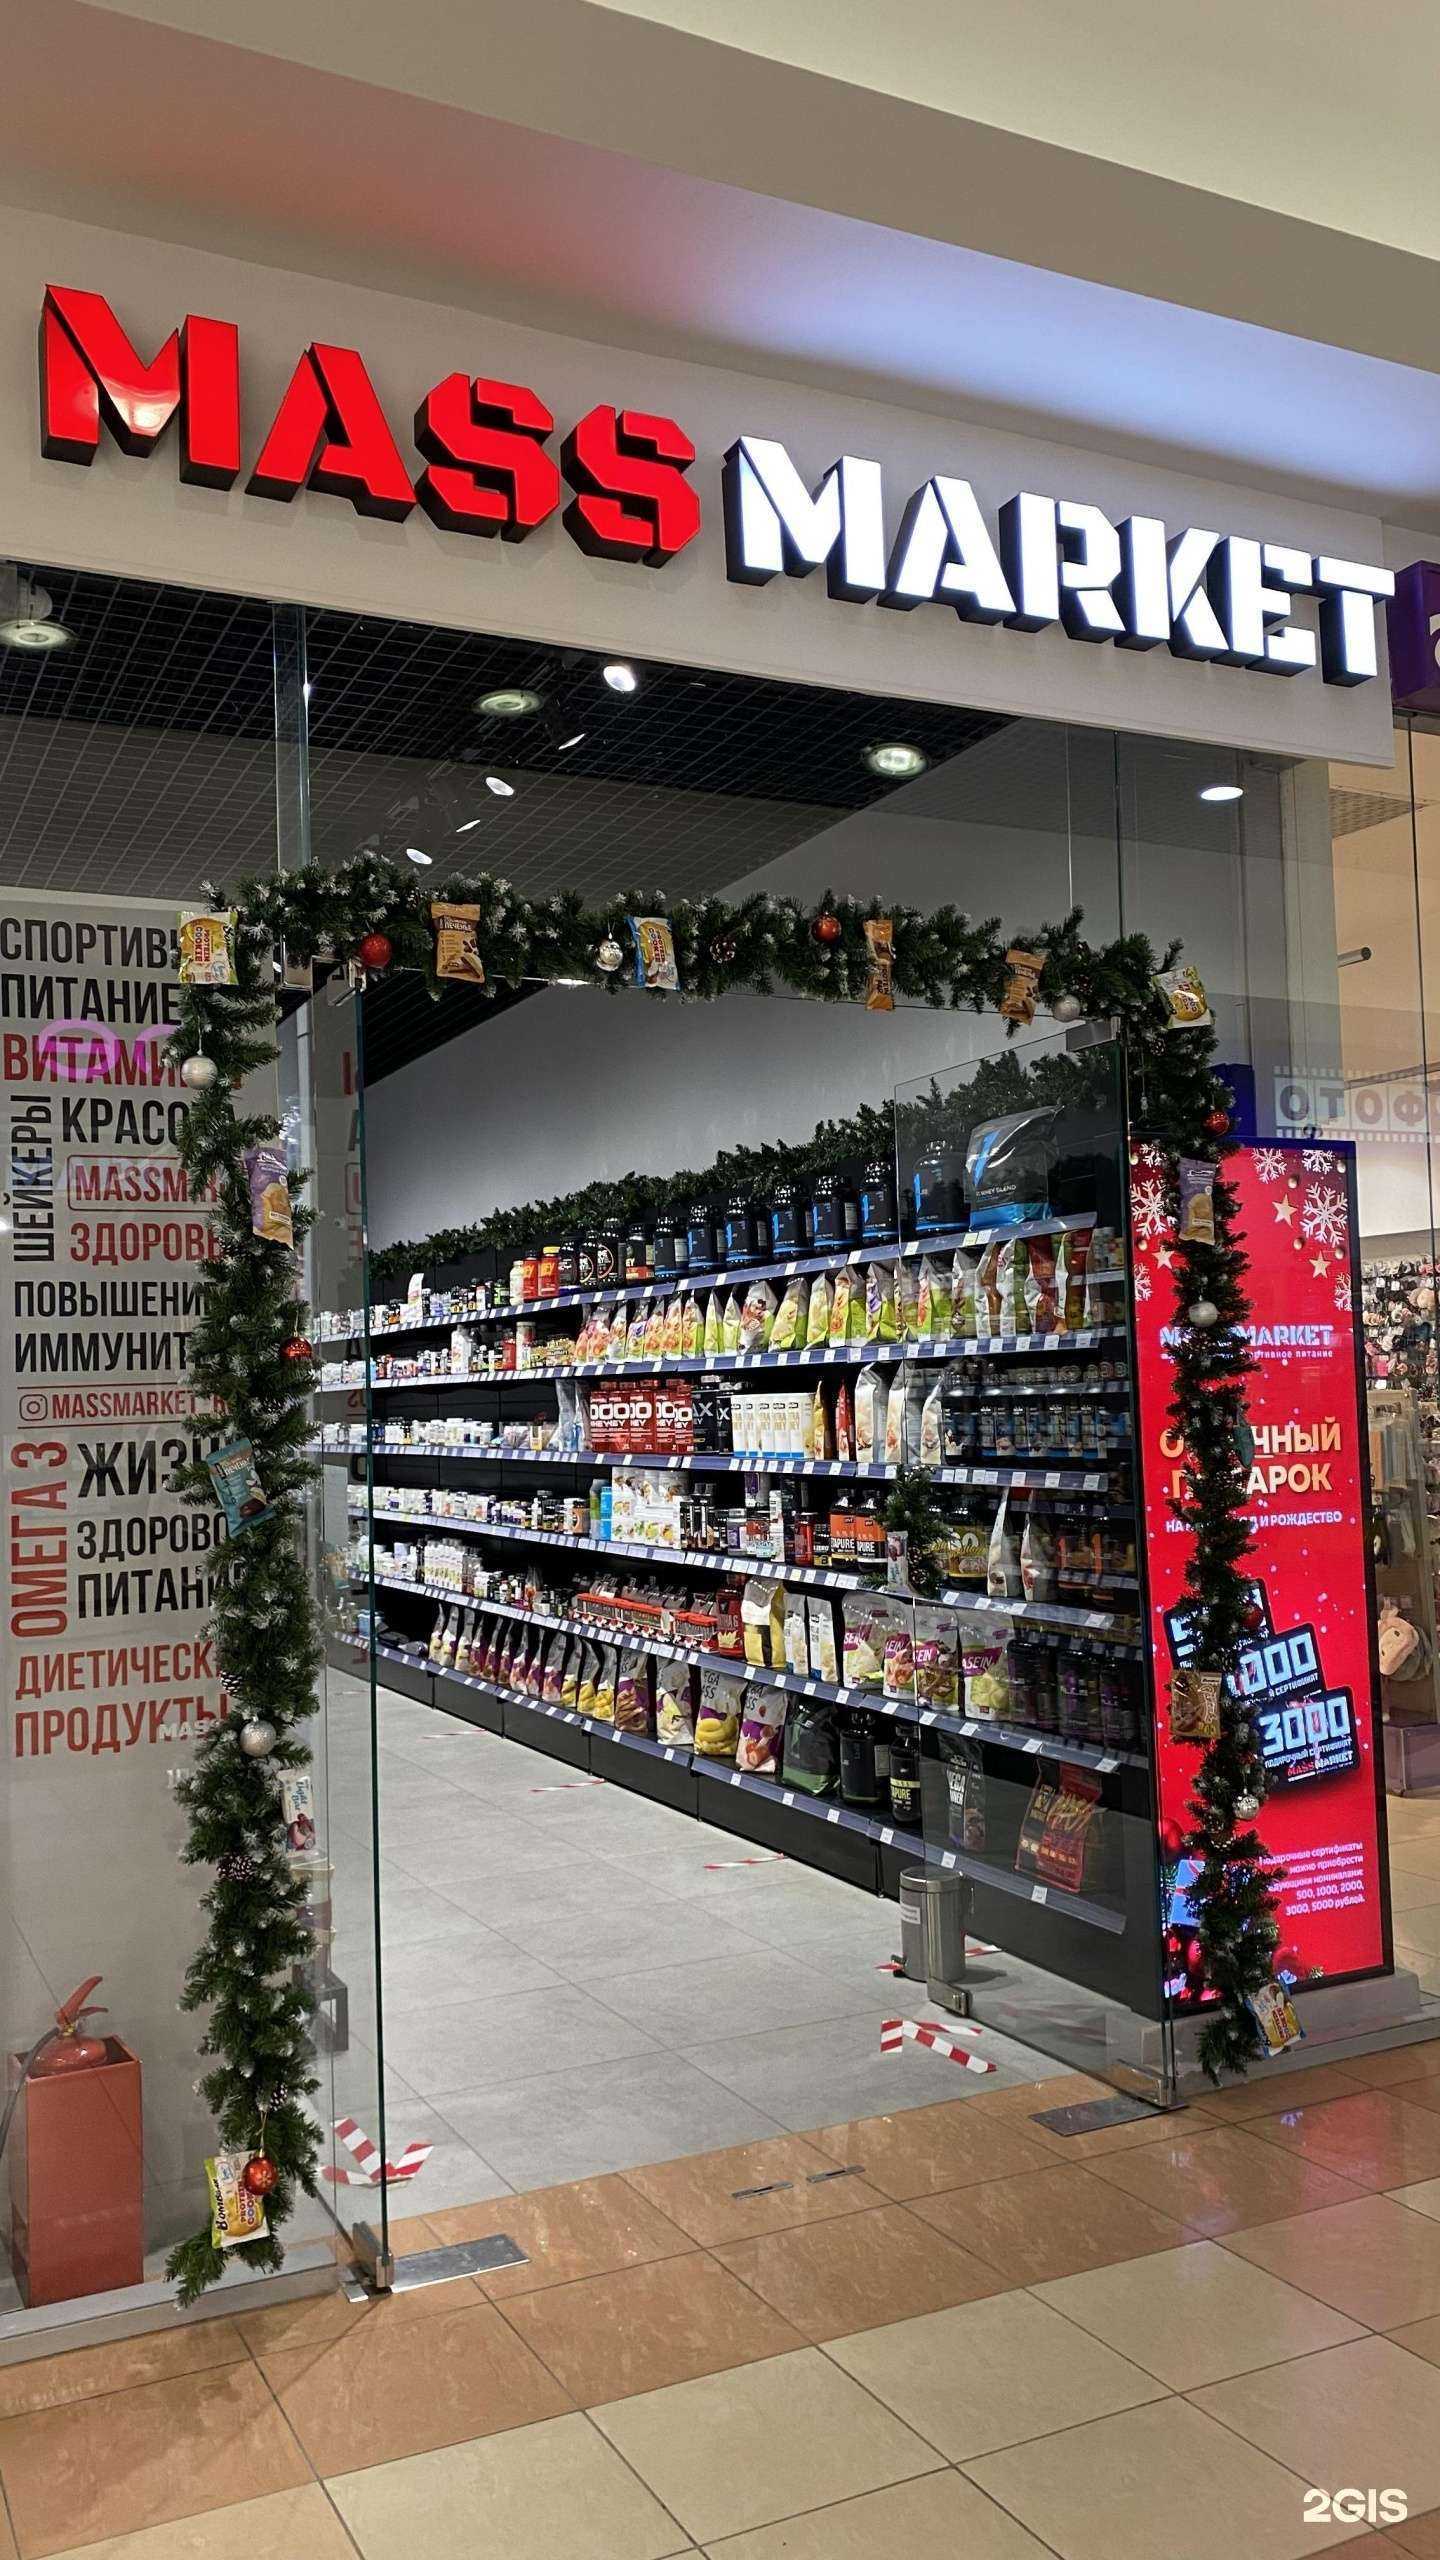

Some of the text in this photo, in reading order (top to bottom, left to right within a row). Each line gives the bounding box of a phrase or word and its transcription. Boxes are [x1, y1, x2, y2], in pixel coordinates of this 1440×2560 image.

[40, 284, 1395, 686] MASS MARKET
[2, 973, 183, 1025] ПИТАНИЕ
[4, 1033, 190, 1088] ВИТАМИ
[63, 1097, 192, 1146] КРАСО
[3, 1095, 54, 1261] ШЕЙКЕРЫ
[70, 1223, 224, 1266] ЗДОРОВЬ
[15, 1332, 194, 1373] ИММУНИТ
[1160, 1416, 1342, 1458] ОЧНЫЙ
[77, 1512, 228, 1563] ЗДОРОВО
[1270, 1510, 1342, 1527] РОЖДЕСТВО
[11, 1481, 68, 1638] ОМЕГА
[15, 1641, 221, 1699] ДИЕТИЧЕСК
[962, 1655, 992, 1669] ASEIN
[15, 1694, 228, 1757] ПРОДУКТЫ
[1259, 1696, 1351, 1756] 3000
[1289, 1855, 1363, 1875] можно приобрести
[1312, 1842, 1363, 1858] сертификаты
[1285, 1902, 1310, 1916] 3000,
[1312, 1898, 1334, 1912] 5000
[1296, 1879, 1365, 1900] 500, 1000, 2000,
